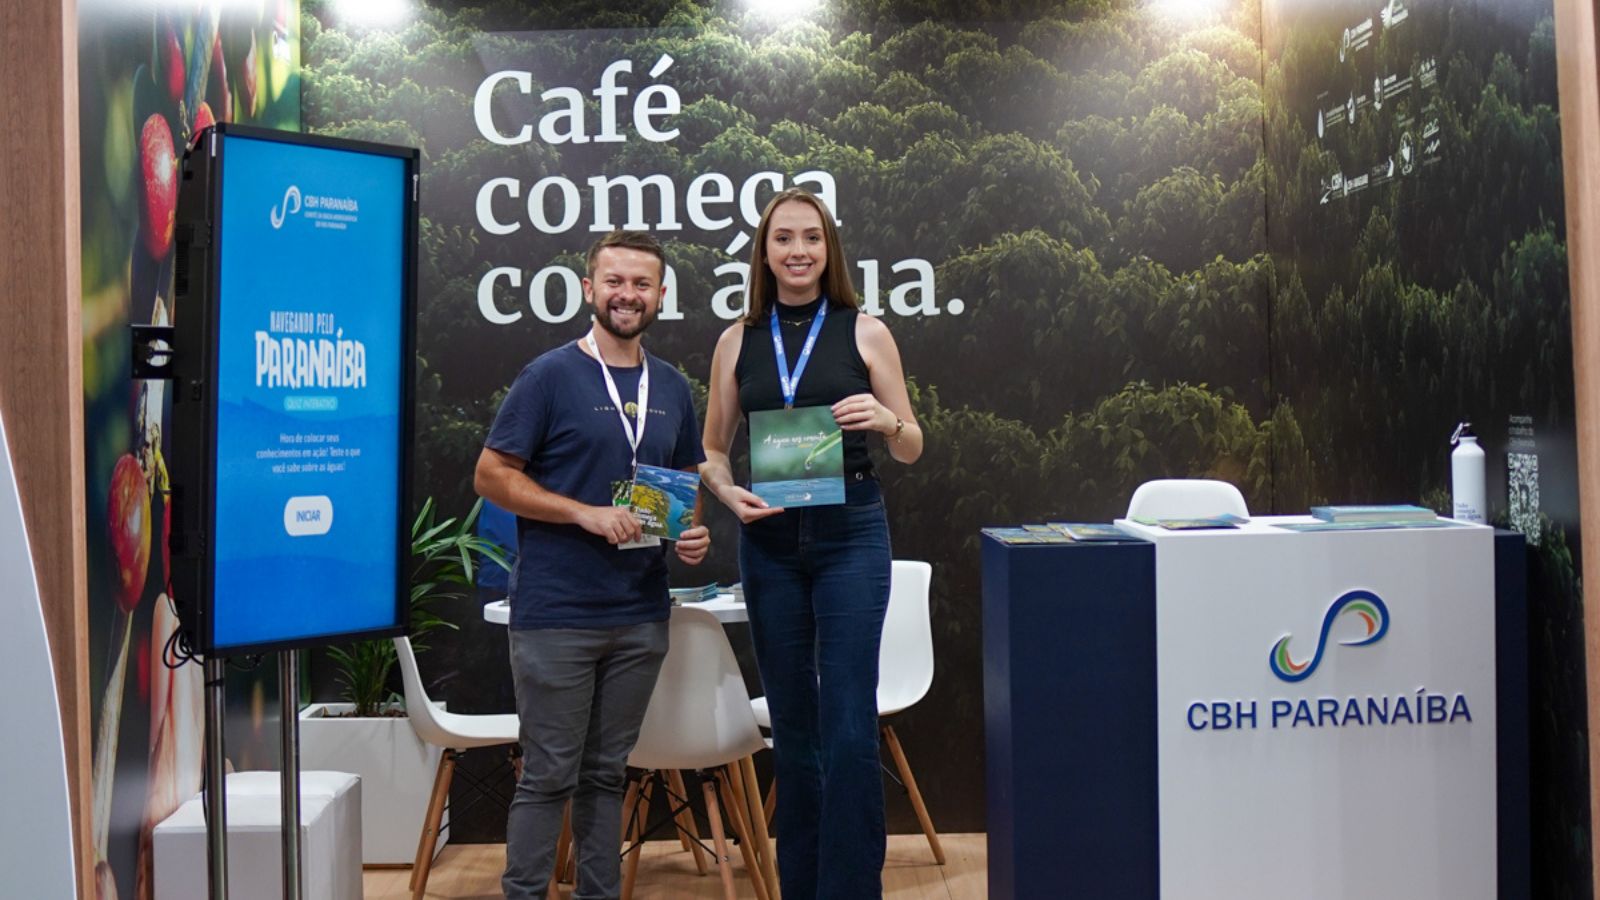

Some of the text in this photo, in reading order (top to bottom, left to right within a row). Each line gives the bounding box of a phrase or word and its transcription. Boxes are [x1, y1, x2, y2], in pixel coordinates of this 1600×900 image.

[473, 53, 682, 146] Café
[304, 195, 358, 211] CBH PARANAÍBA
[270, 311, 334, 334] NAVEGANDO PELO
[255, 327, 366, 389] PARANAÍBA
[280, 434, 294, 443] Hora
[295, 434, 303, 443] de
[304, 433, 325, 443] colocar
[256, 448, 301, 459] conhecimentos
[302, 450, 312, 458] em
[330, 447, 344, 457] Teste
[350, 449, 361, 458] que
[272, 463, 286, 473] você
[287, 463, 300, 472] sabe
[302, 462, 318, 472] sobre
[296, 510, 321, 522] INICIAR
[1187, 687, 1473, 731] CBH PARANAÍBA
